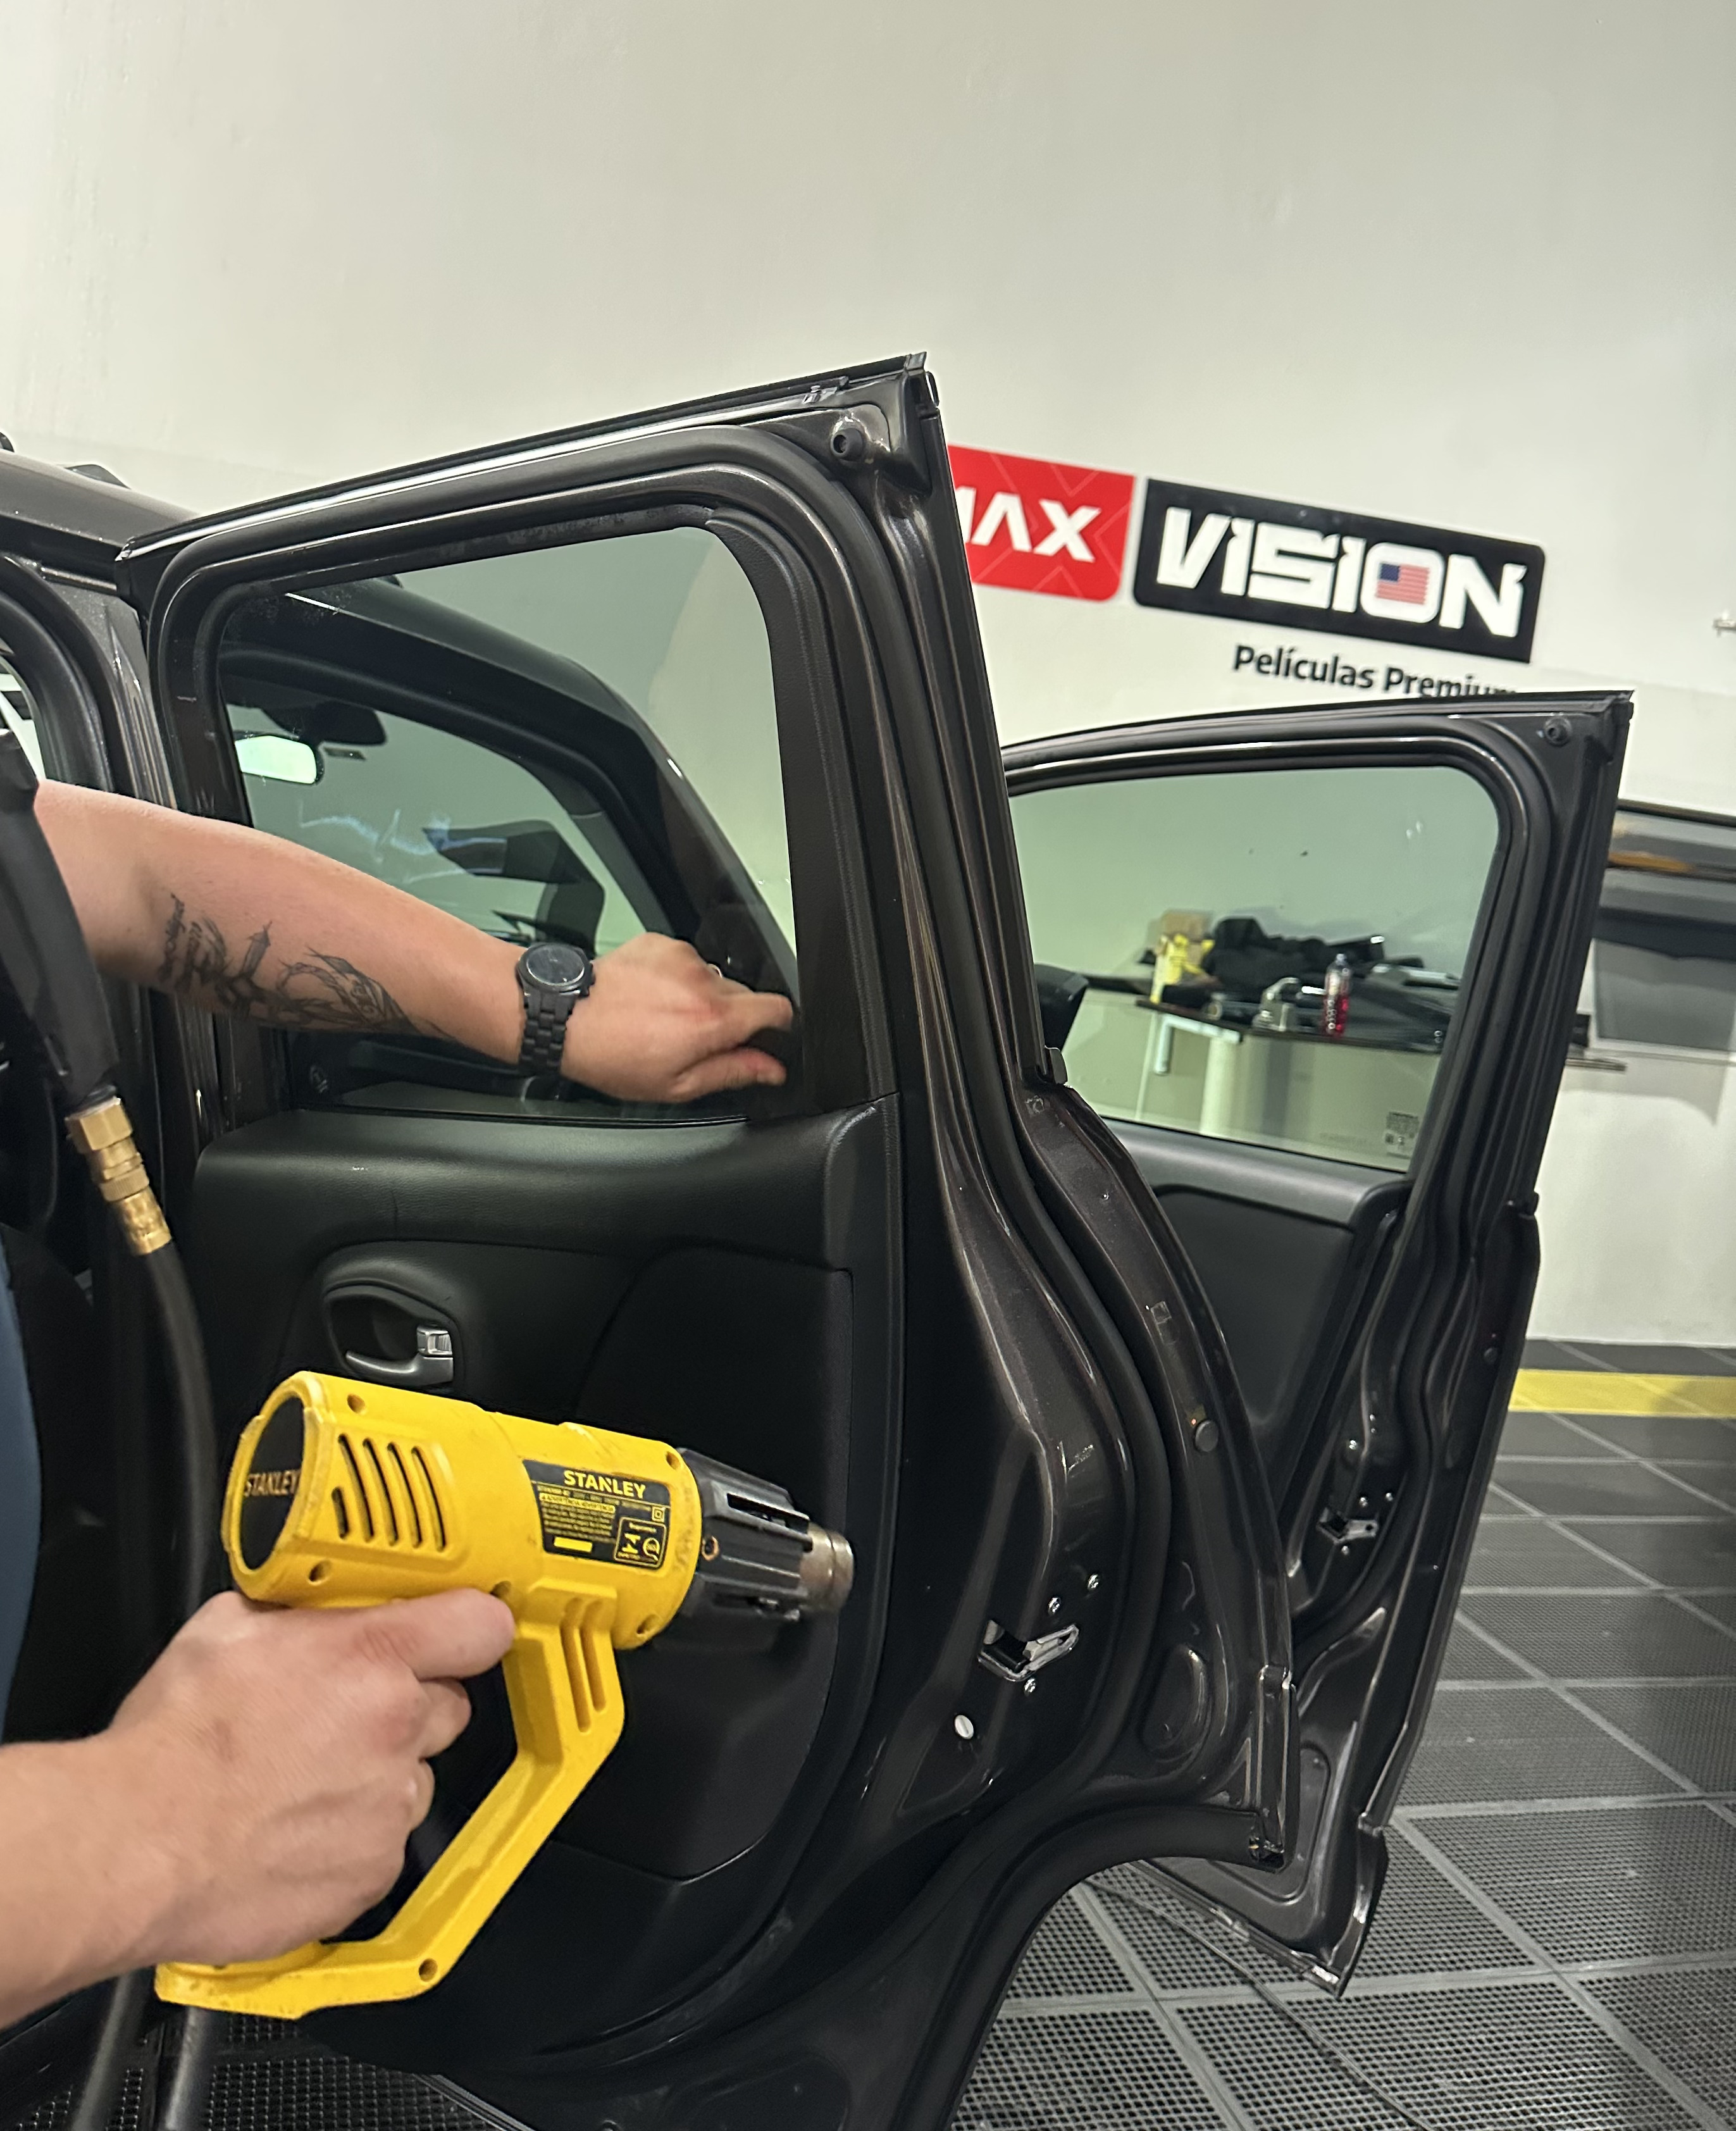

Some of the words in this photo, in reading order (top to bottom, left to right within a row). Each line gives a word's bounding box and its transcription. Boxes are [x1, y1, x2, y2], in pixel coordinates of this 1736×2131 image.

[1156, 506, 1527, 638] VISION
[1234, 645, 1374, 689] Películas
[564, 1470, 646, 1500] STANLEY
